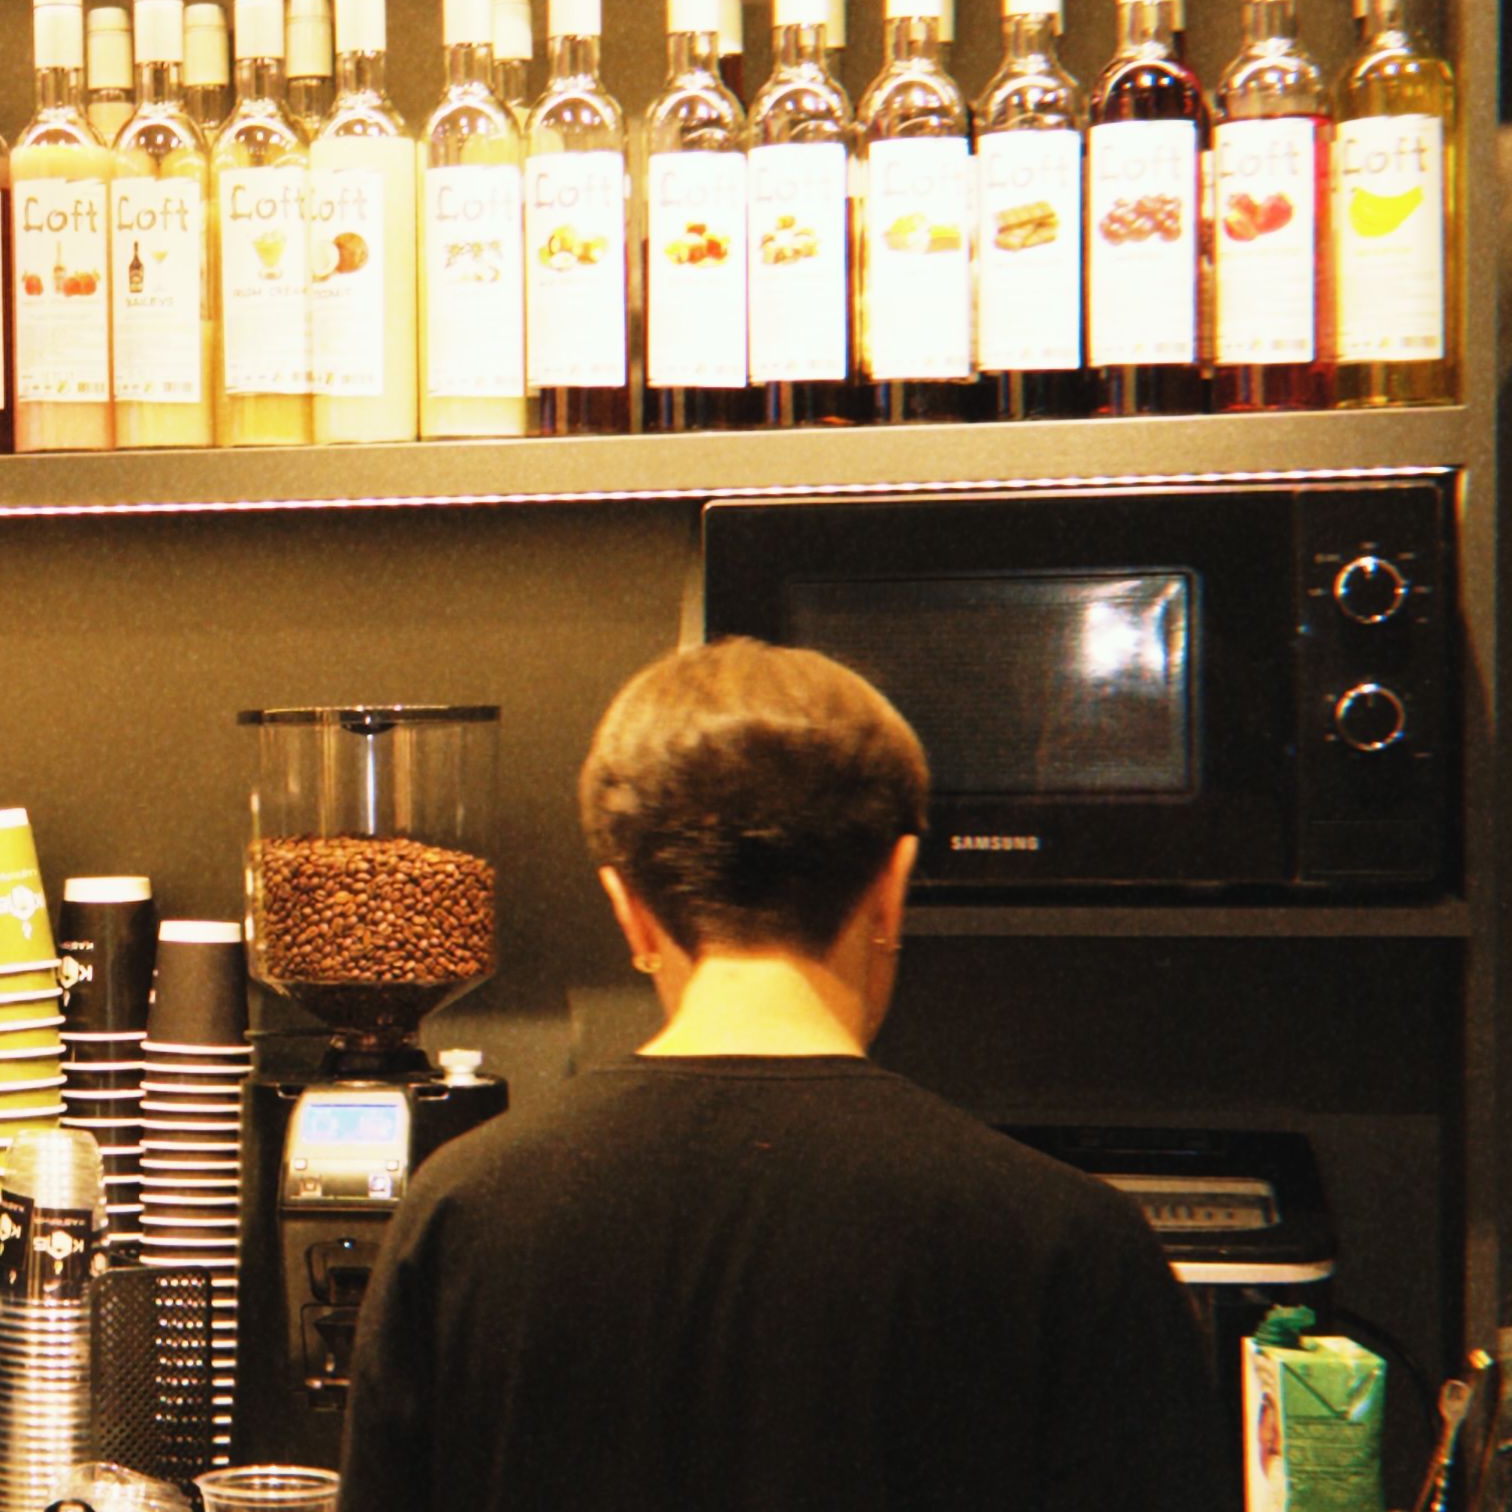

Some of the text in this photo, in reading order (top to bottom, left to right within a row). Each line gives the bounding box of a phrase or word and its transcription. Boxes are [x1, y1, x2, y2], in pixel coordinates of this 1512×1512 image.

[23, 196, 98, 234] Loft
[116, 195, 190, 233] Loft
[951, 835, 1039, 851] SAMSUNG
